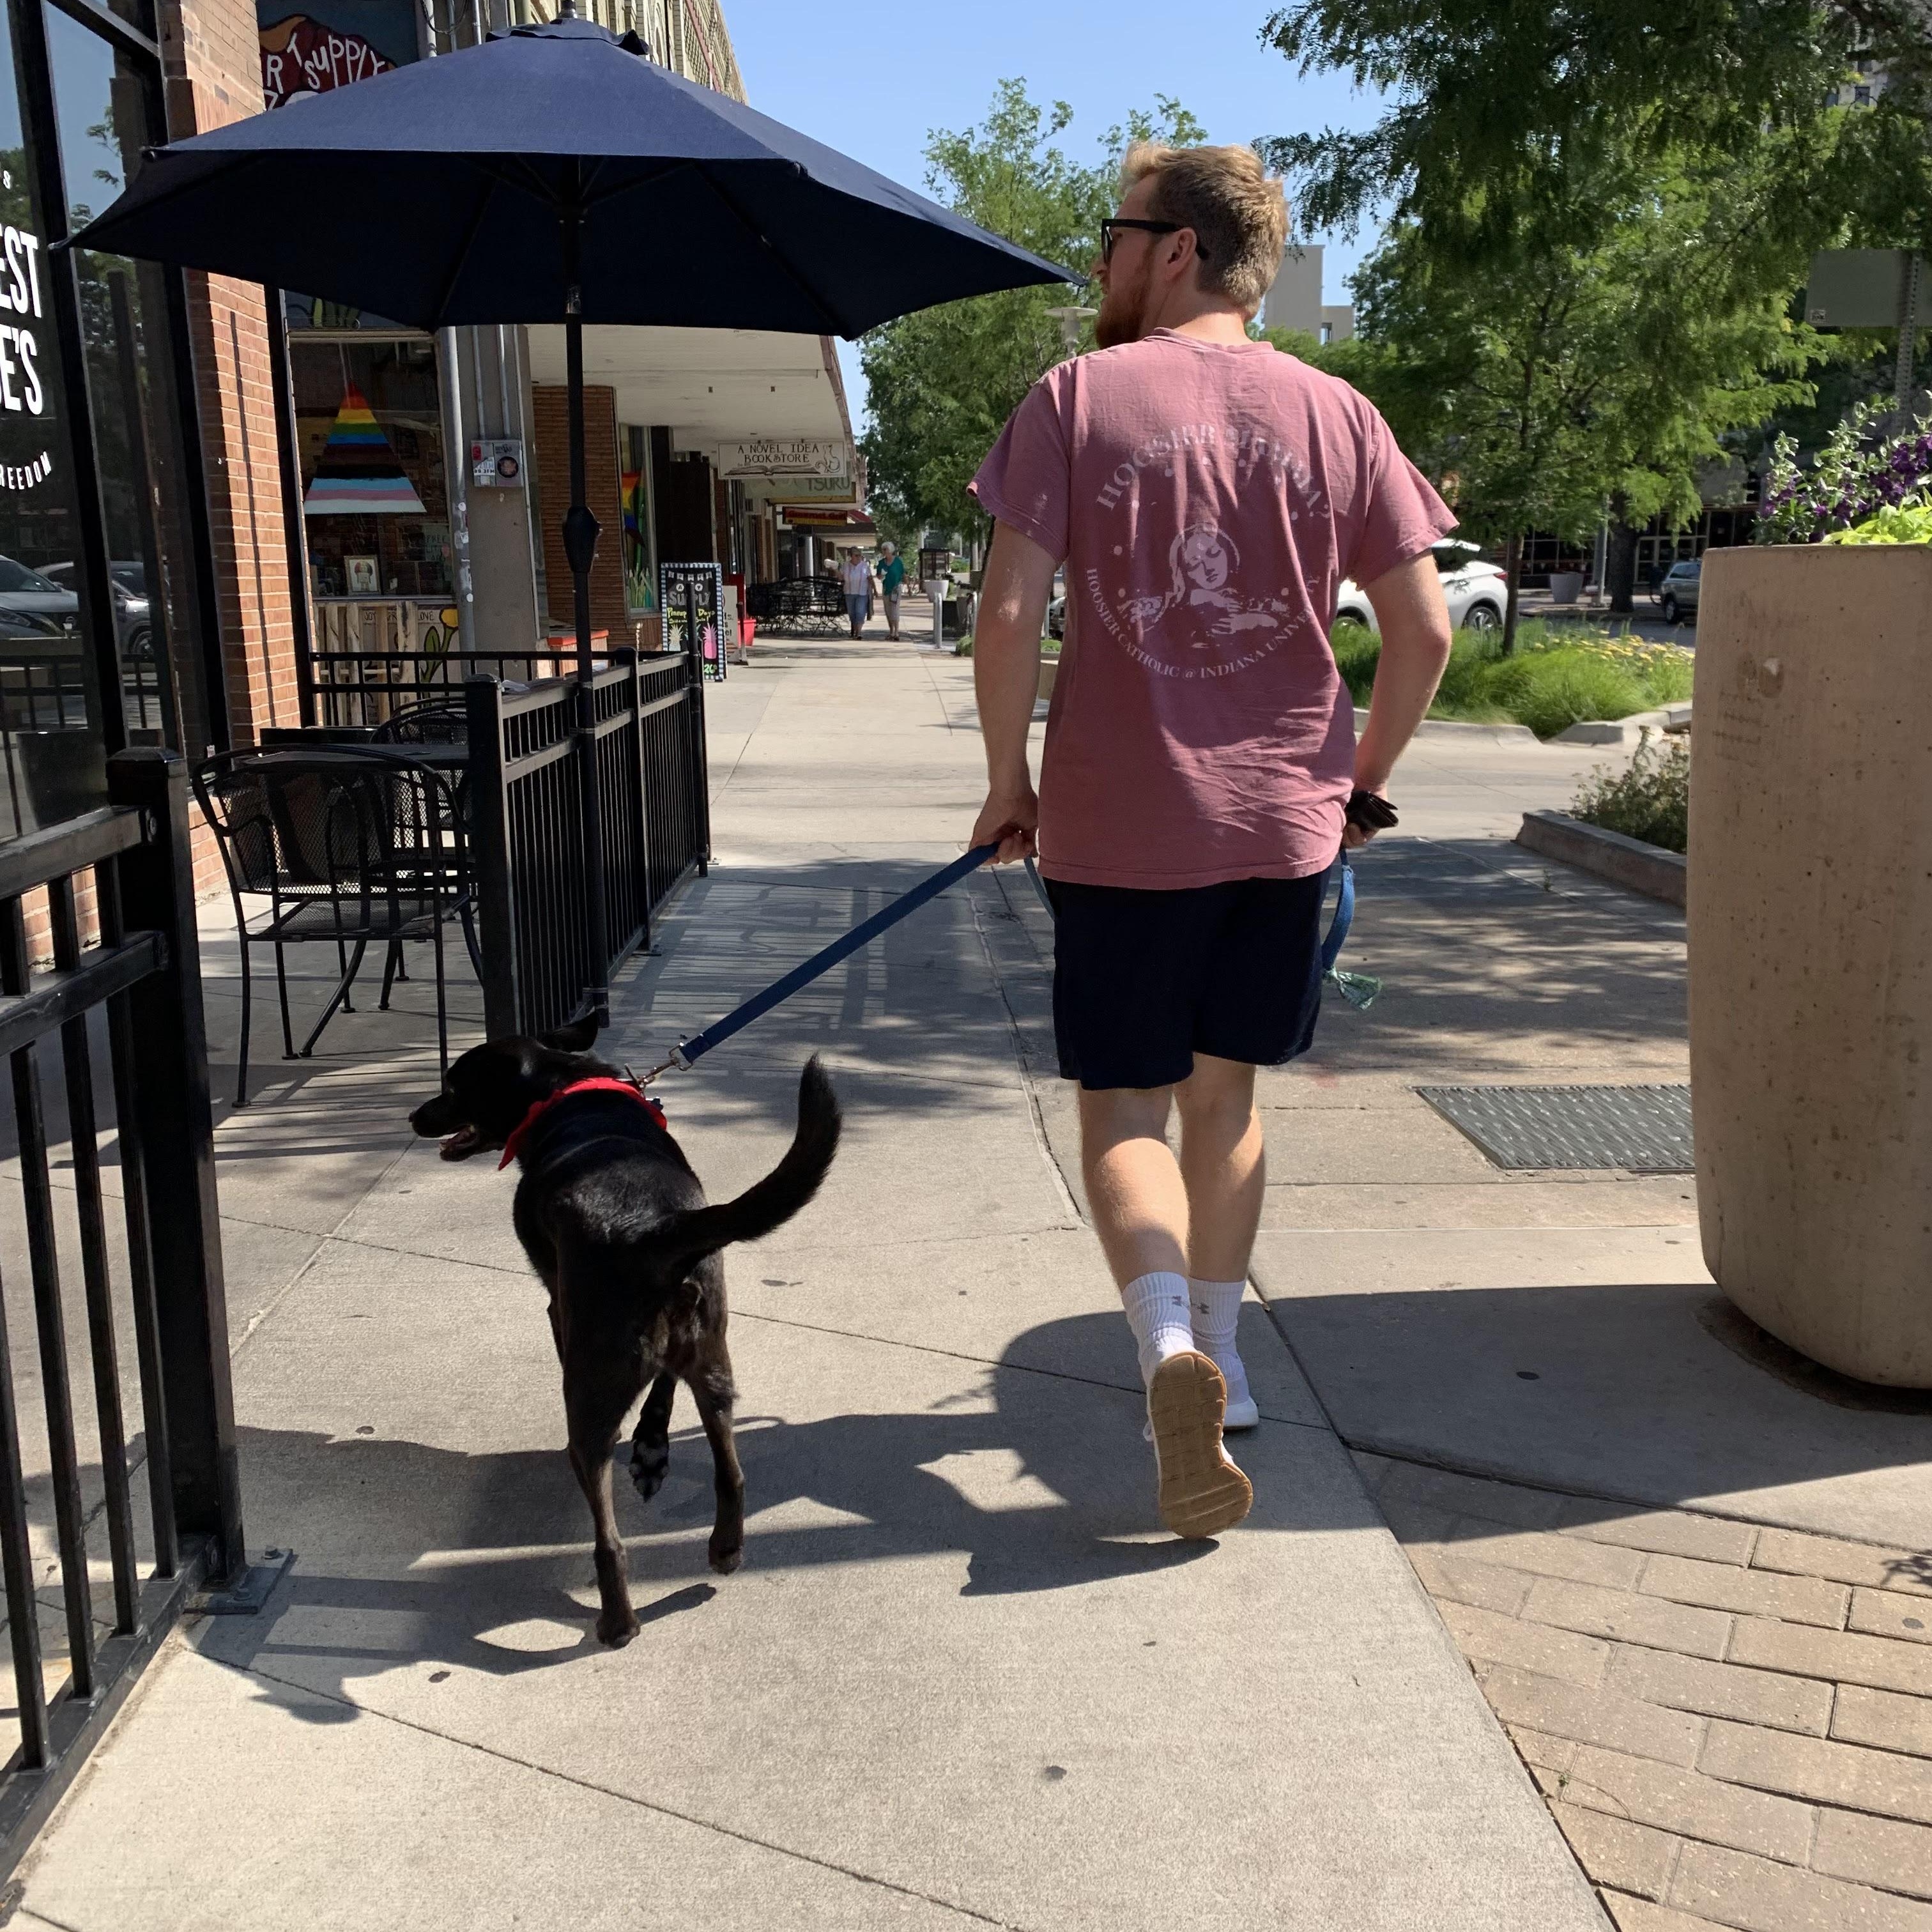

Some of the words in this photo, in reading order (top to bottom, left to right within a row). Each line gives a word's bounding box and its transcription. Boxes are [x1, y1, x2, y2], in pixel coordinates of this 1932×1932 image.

[266, 33, 302, 94] RT
[305, 34, 385, 89] SUPPLY
[0, 323, 43, 415] E'S
[0, 451, 51, 490] REEDOM
[738, 445, 744, 454] A
[750, 443, 783, 454] NOVEL
[790, 443, 819, 453] IDEA
[744, 454, 810, 463] BOOKSTORE
[1096, 425, 1216, 510] HOOSIER
[669, 591, 710, 606] SULY
[1086, 568, 1120, 636] HOOSIER
[1119, 634, 1180, 677] CATHOLIC
[1183, 668, 1195, 678] @
[1200, 650, 1266, 678] INDIANA
[1266, 576, 1321, 651] UNIVEY
